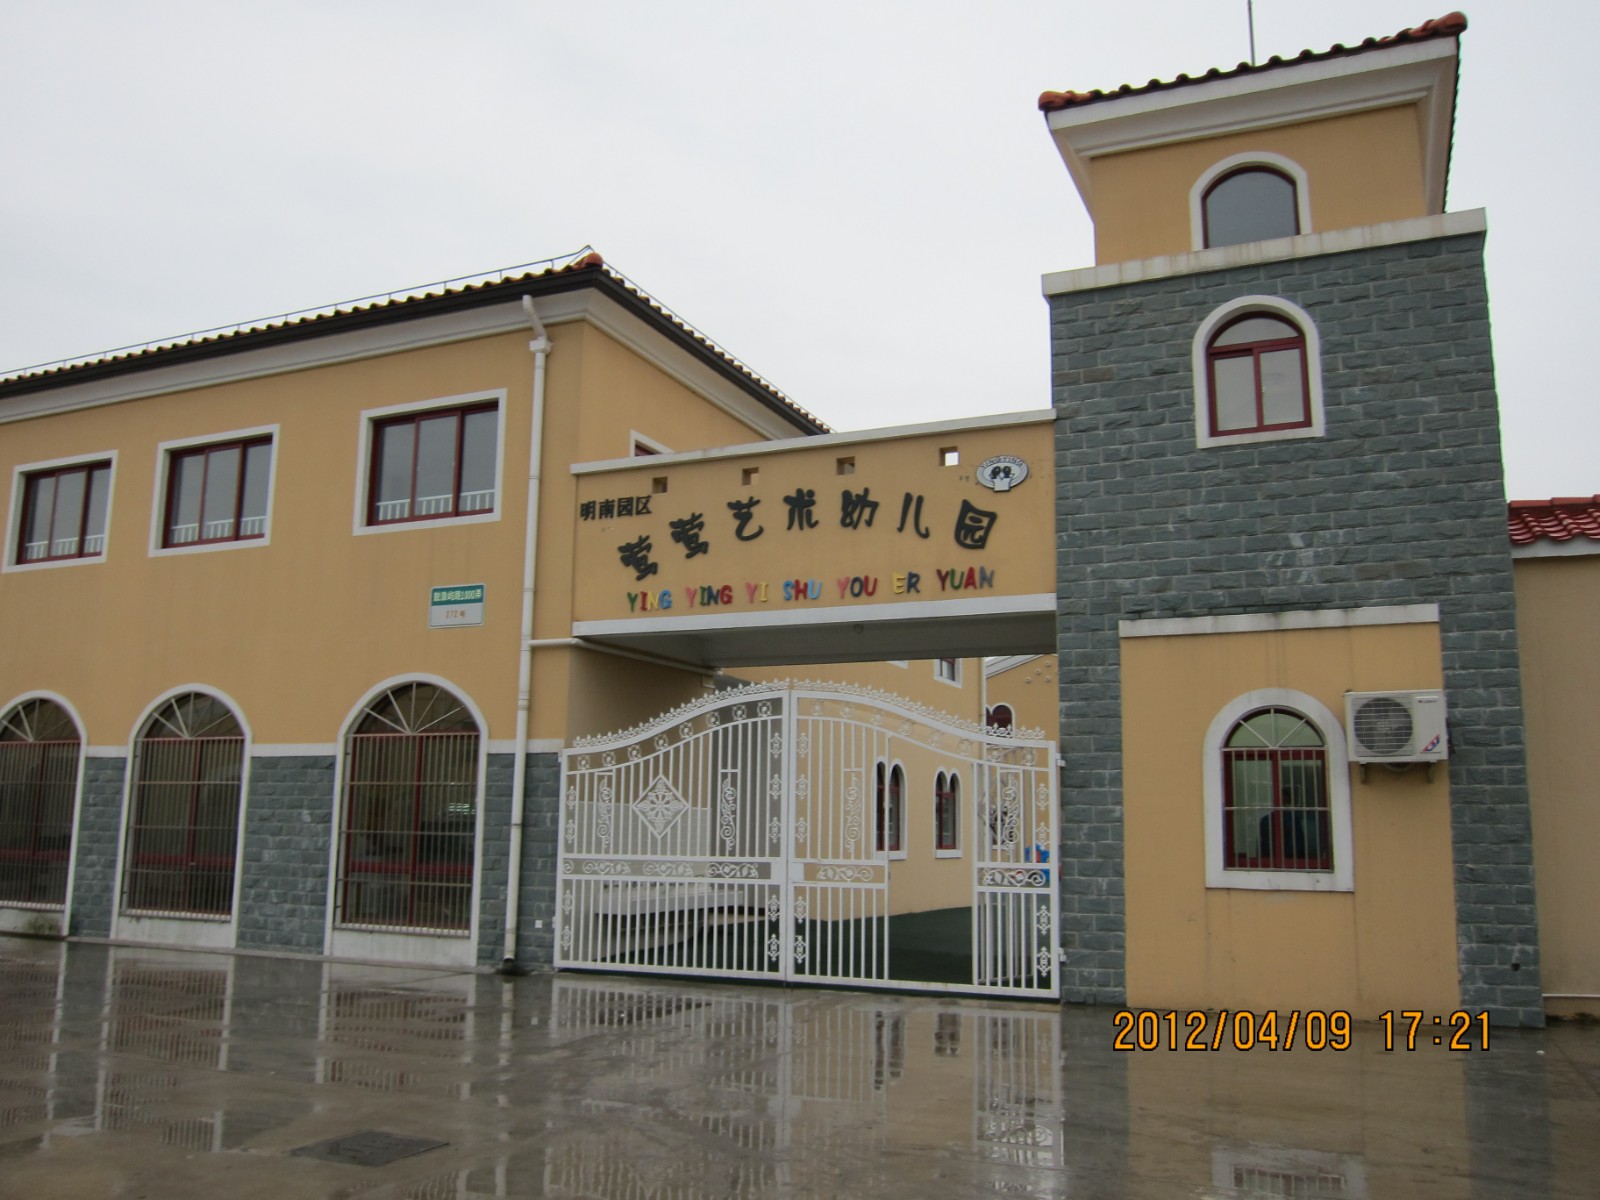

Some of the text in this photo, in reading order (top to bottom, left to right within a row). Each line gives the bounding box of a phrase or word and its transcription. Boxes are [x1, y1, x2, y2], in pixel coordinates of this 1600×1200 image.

[579, 495, 652, 521] 明南园区
[626, 566, 994, 613] YING YING YI SHU YOU ER YUAN
